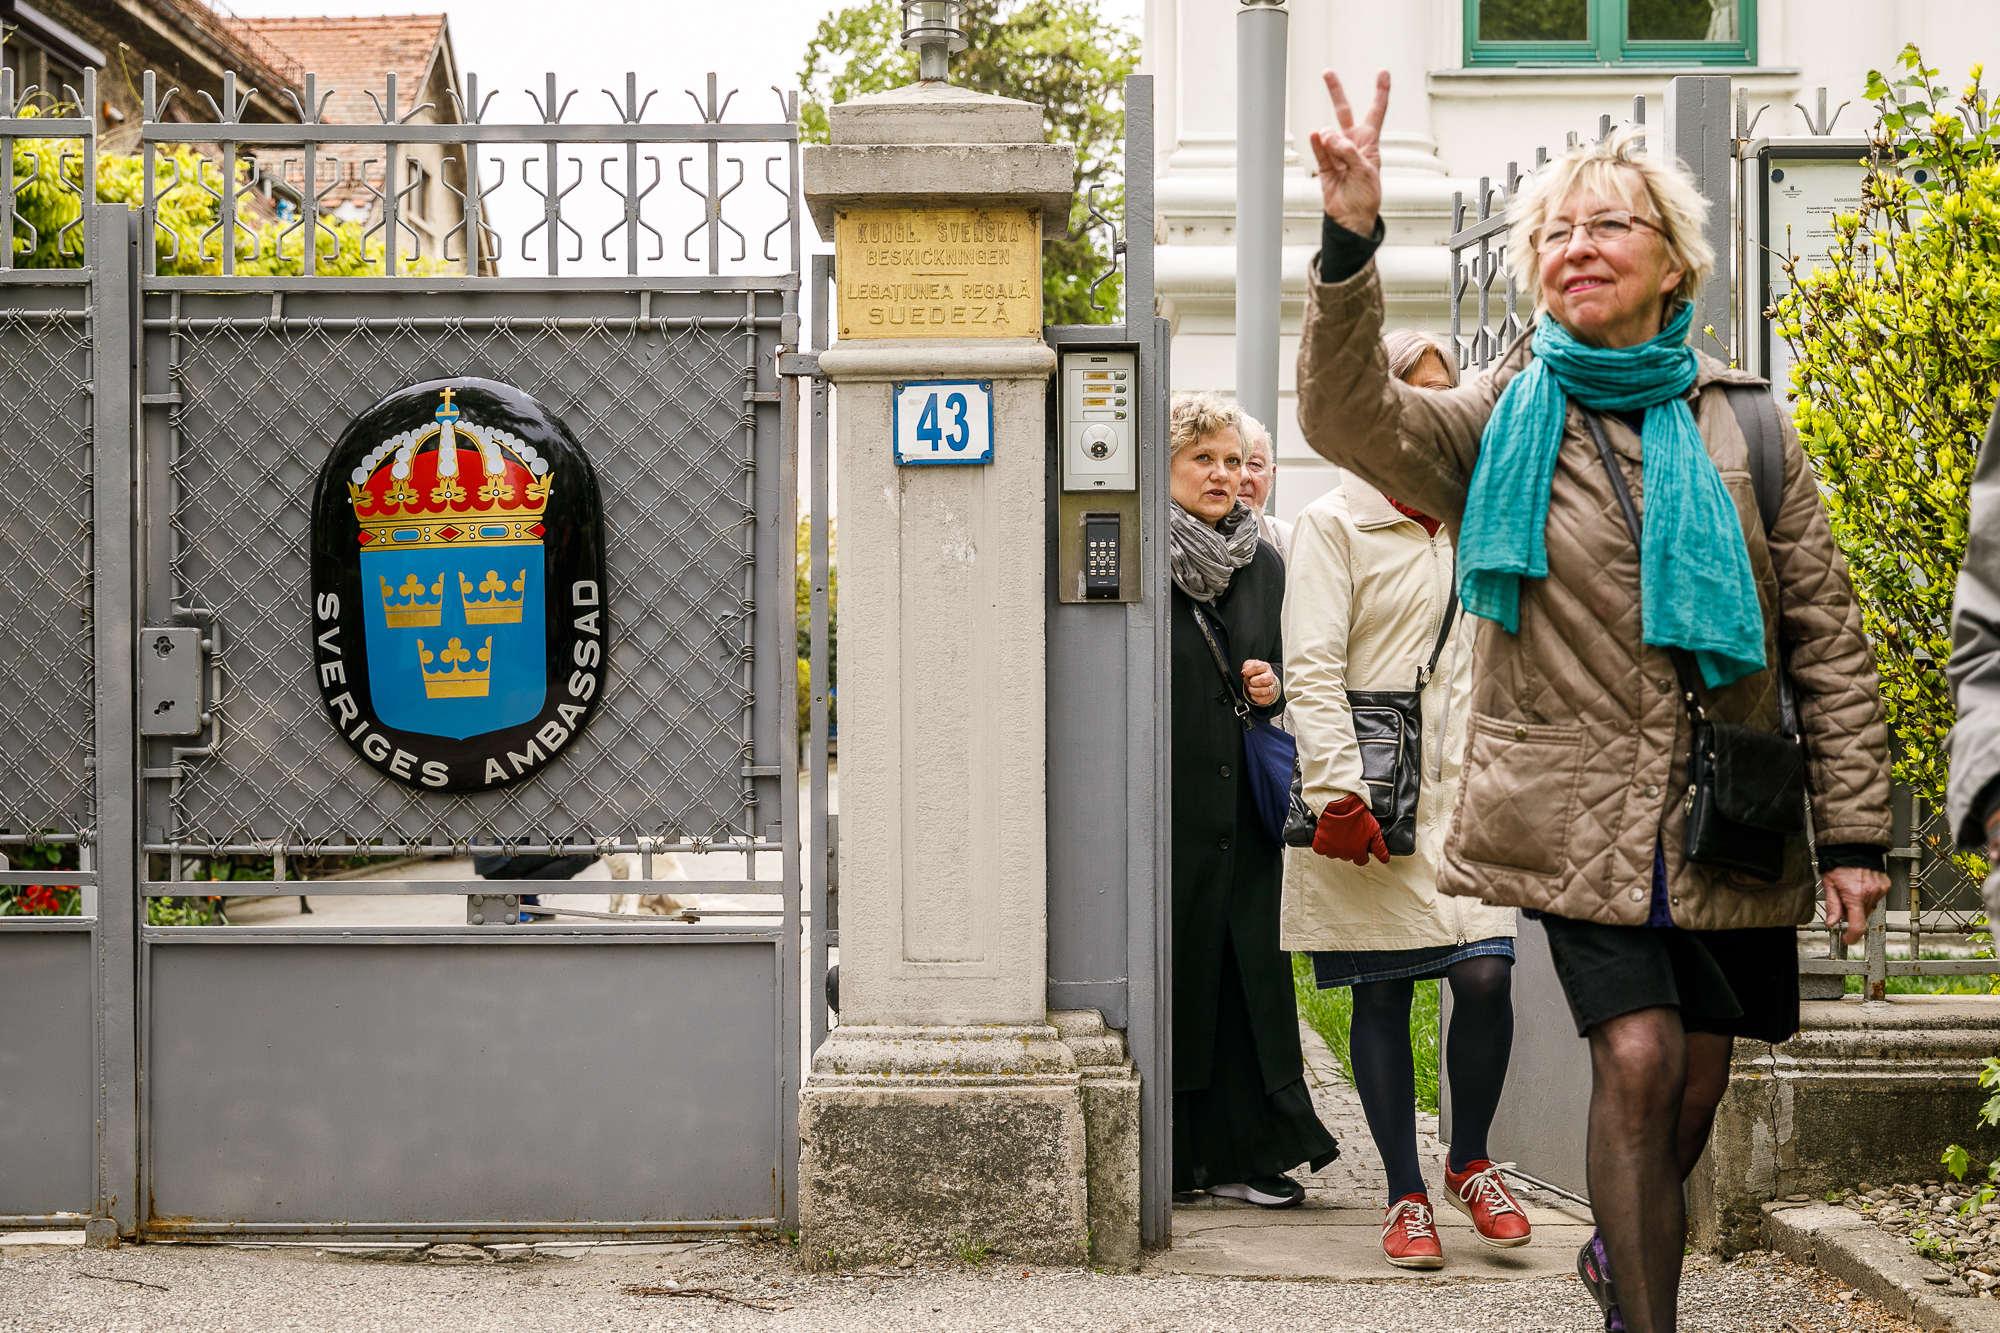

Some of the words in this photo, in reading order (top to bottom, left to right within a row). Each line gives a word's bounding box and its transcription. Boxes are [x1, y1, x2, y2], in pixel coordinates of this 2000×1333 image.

[856, 222, 921, 243] KUNGL.
[938, 221, 1019, 243] SVENSKA
[866, 248, 1010, 266] BESKICKNINGEN
[962, 278, 1031, 299] REGALĂ
[868, 302, 1011, 324] SUEDEZĂ
[916, 392, 970, 452] 43
[317, 592, 449, 787] SVERIGES
[484, 580, 600, 785] AMBASSAD
